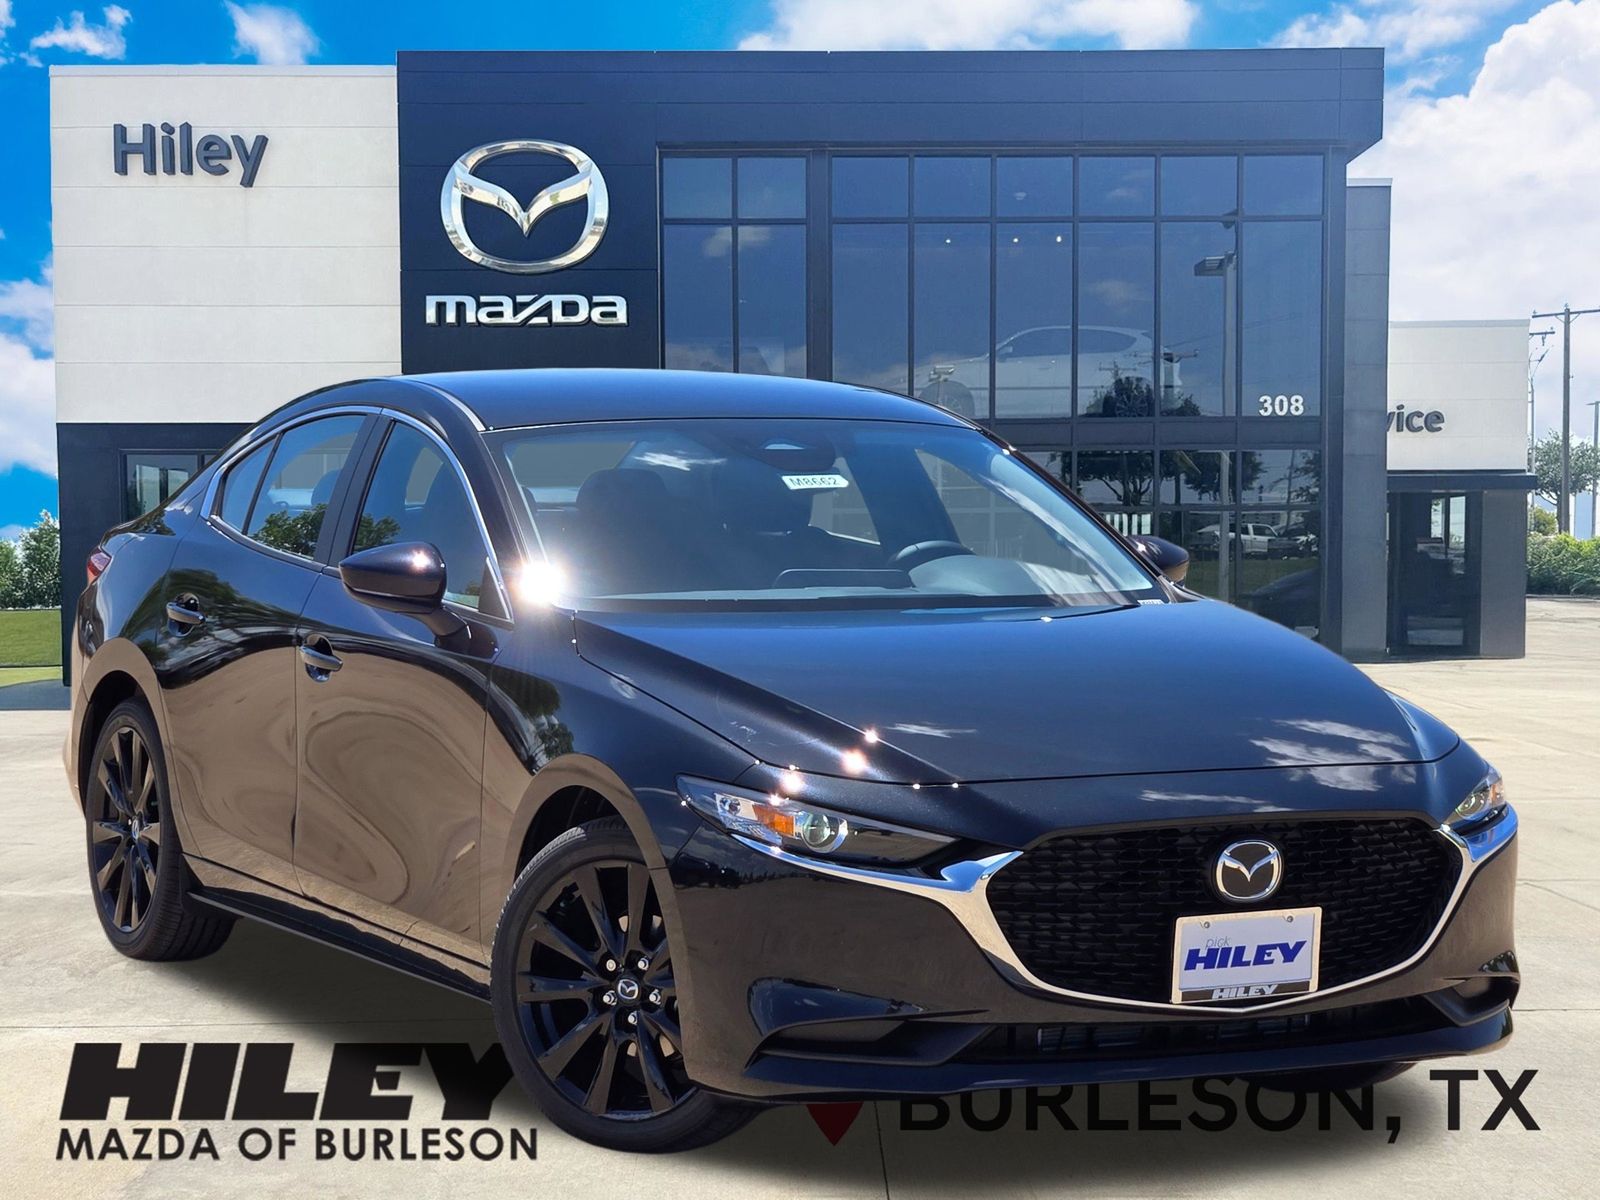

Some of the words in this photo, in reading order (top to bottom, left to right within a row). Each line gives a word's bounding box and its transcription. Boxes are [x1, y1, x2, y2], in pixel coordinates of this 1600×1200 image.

[113, 122, 269, 188] Hiley
[1258, 394, 1304, 417] 308
[1205, 935, 1231, 948] pick
[1184, 940, 1307, 971] HILEY
[1211, 984, 1279, 1000] HILEY
